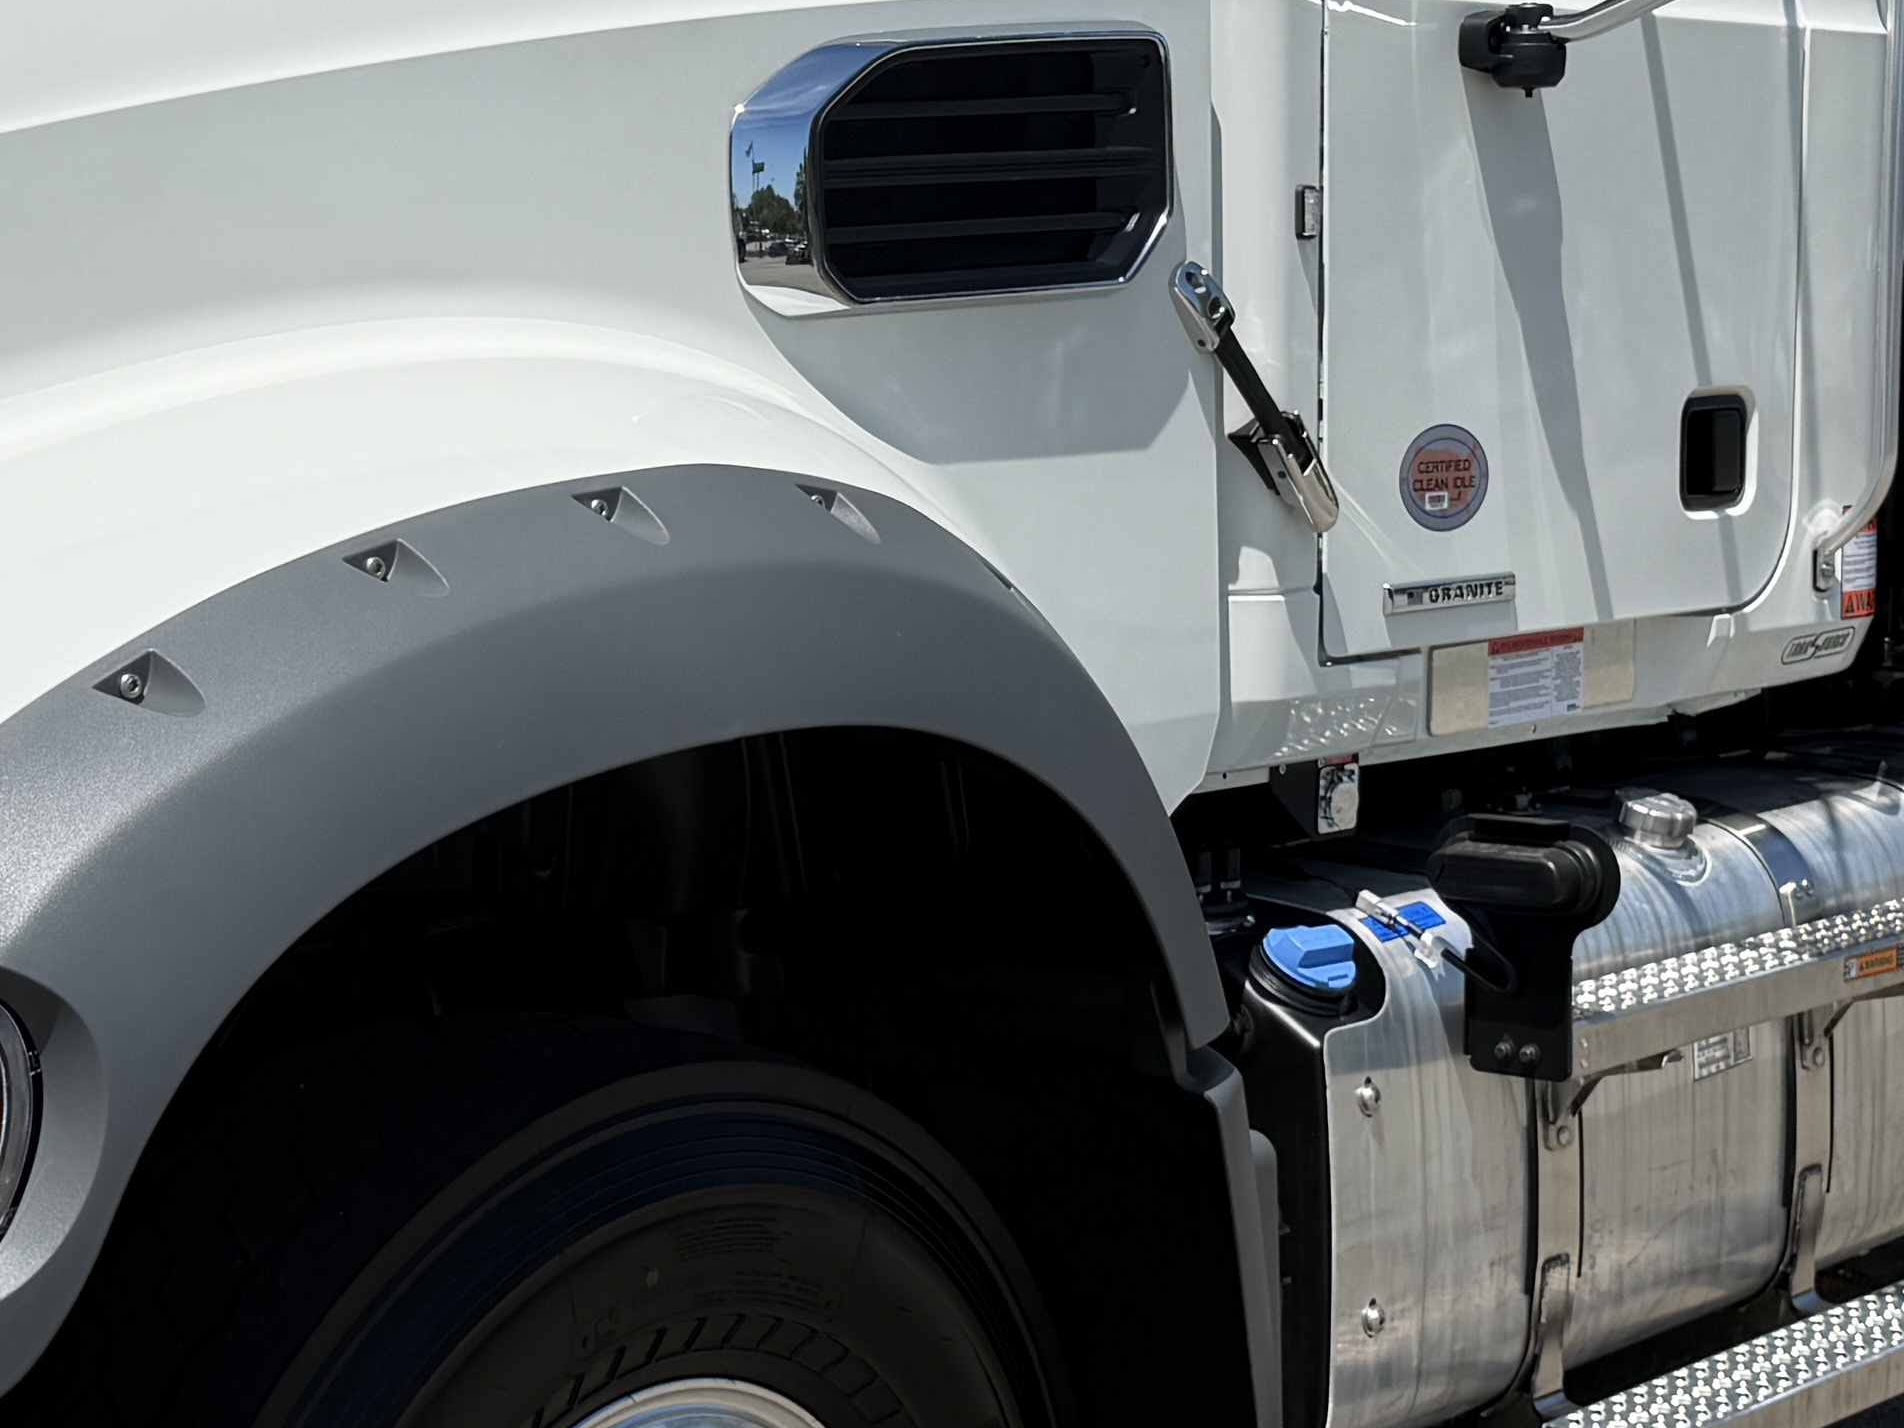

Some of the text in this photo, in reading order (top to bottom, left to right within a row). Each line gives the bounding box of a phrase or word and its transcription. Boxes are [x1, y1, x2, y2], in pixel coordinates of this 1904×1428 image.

[1418, 459, 1471, 474] CERTIFIED
[1413, 475, 1476, 492] CLEAN IDLE
[1428, 580, 1504, 604] GRANITE
